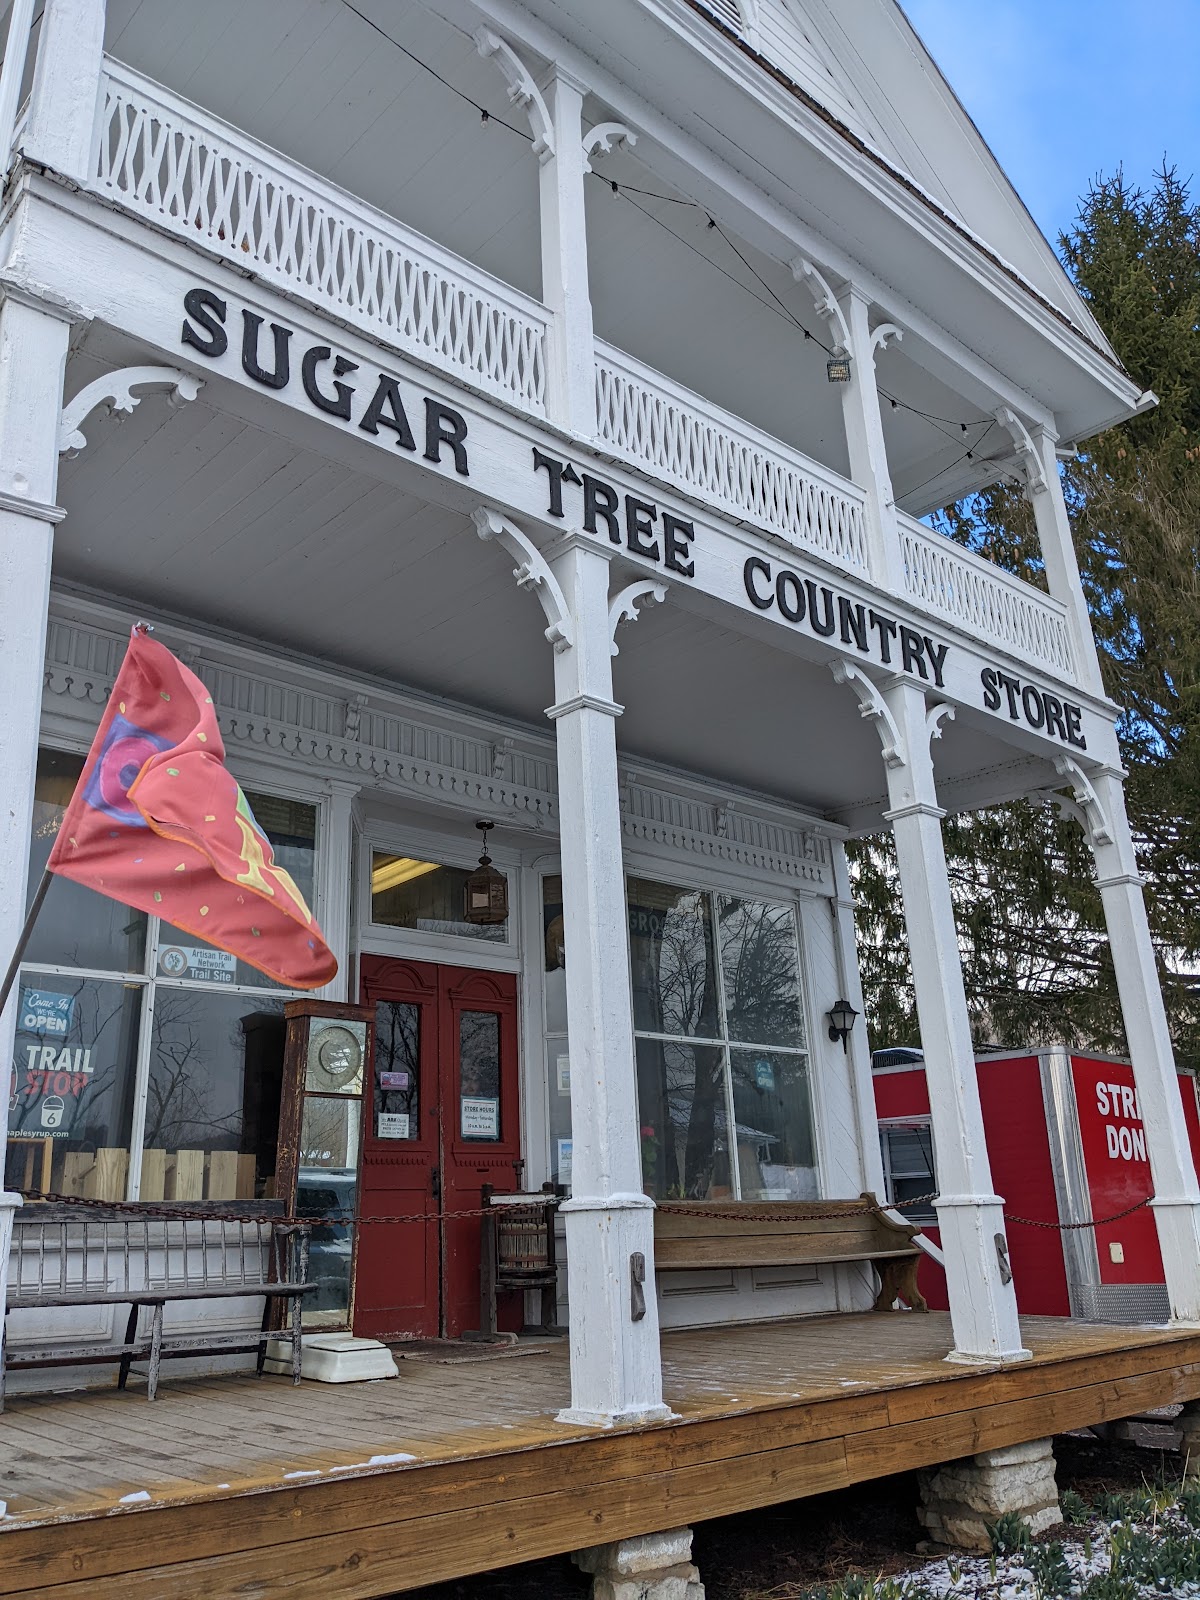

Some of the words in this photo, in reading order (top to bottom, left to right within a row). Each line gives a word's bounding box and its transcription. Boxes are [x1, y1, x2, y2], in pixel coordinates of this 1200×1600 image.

[181, 288, 470, 476] SUGAR
[532, 447, 695, 578] TREE
[743, 557, 950, 688] COUNTRY
[981, 667, 1087, 750] STORE
[192, 949, 216, 960] Artisan
[218, 952, 232, 961] Trail
[198, 959, 226, 969] Network
[190, 968, 210, 980] Trail
[213, 970, 231, 982] Site
[28, 993, 54, 1008] Come
[55, 998, 70, 1010] In
[36, 1008, 56, 1017] WE'RE
[24, 1014, 67, 1031] OPEN
[26, 1045, 94, 1073] TRAIL
[23, 1069, 88, 1097] STOP
[47, 1112, 56, 1125] 6
